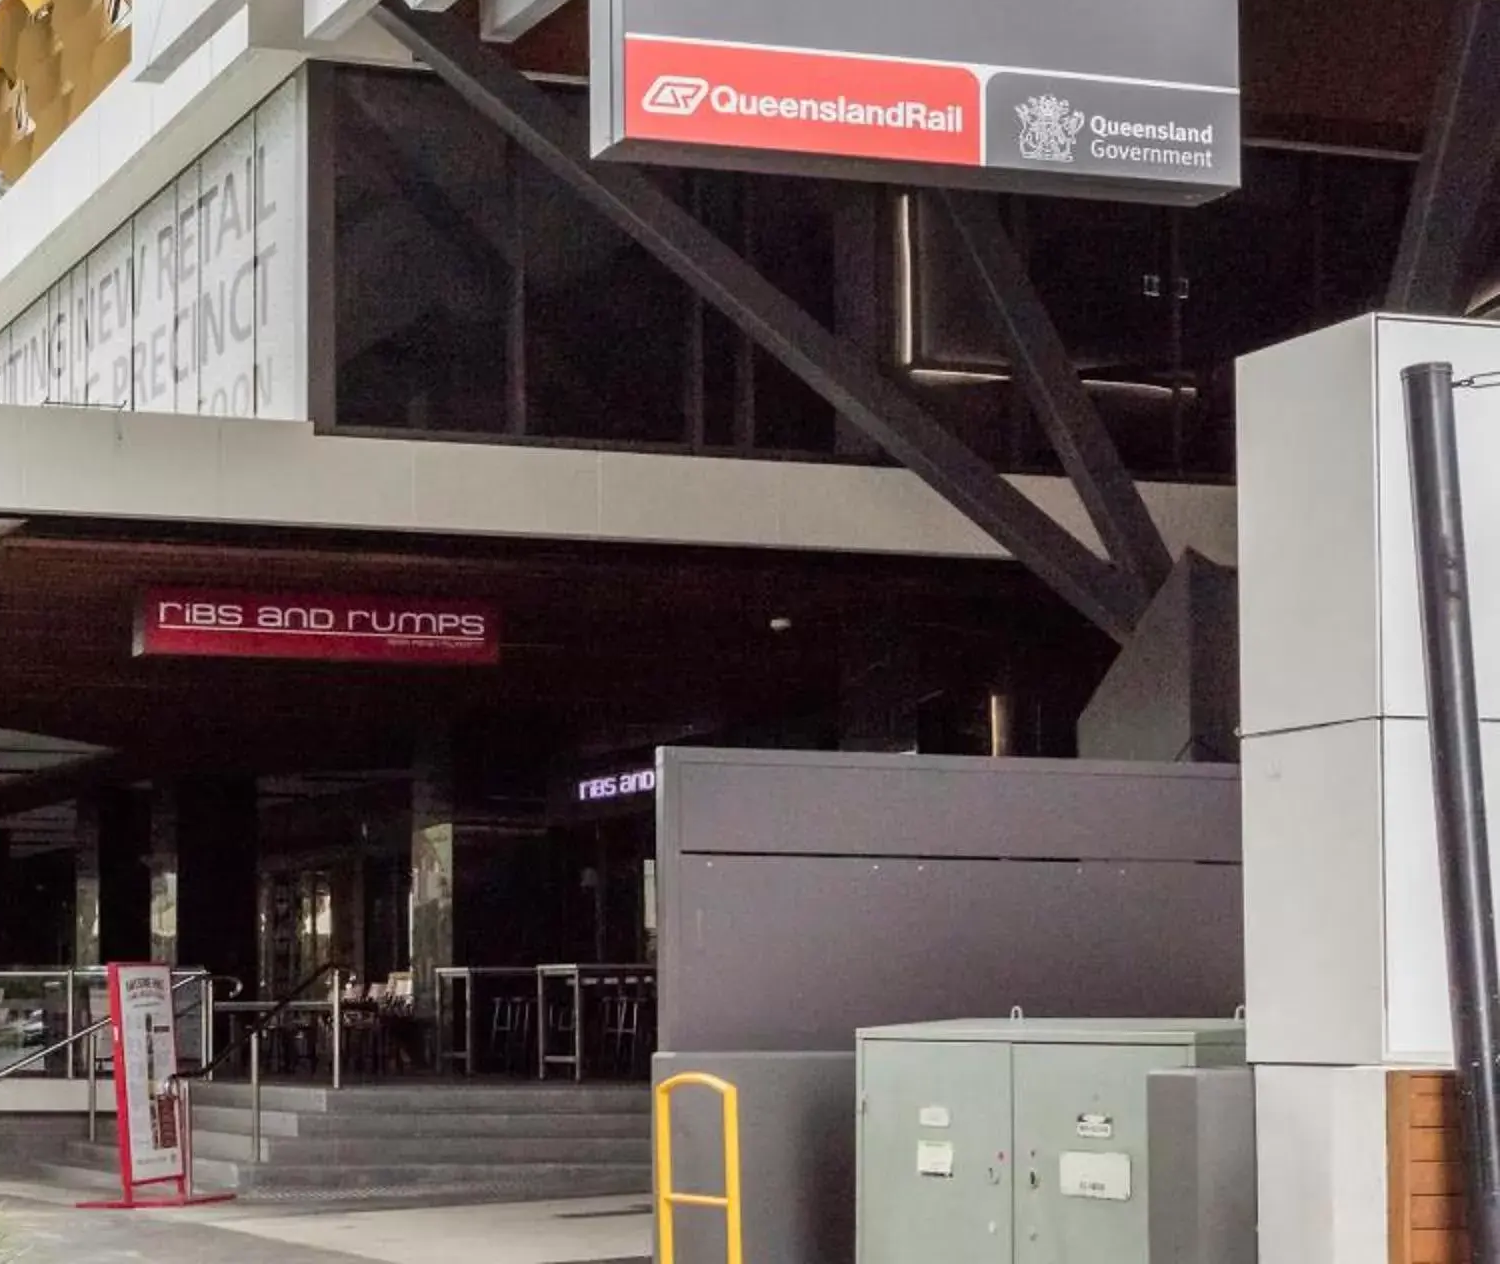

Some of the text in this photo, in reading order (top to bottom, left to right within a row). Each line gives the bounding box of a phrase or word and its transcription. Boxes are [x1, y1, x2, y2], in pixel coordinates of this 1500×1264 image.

[710, 84, 963, 133] QueenslandRail
[1090, 115, 1214, 144] Queensland
[1090, 138, 1214, 167] Government
[77, 244, 146, 362] NEW
[156, 145, 277, 301] RETAIL
[112, 241, 278, 405] PRECINCT
